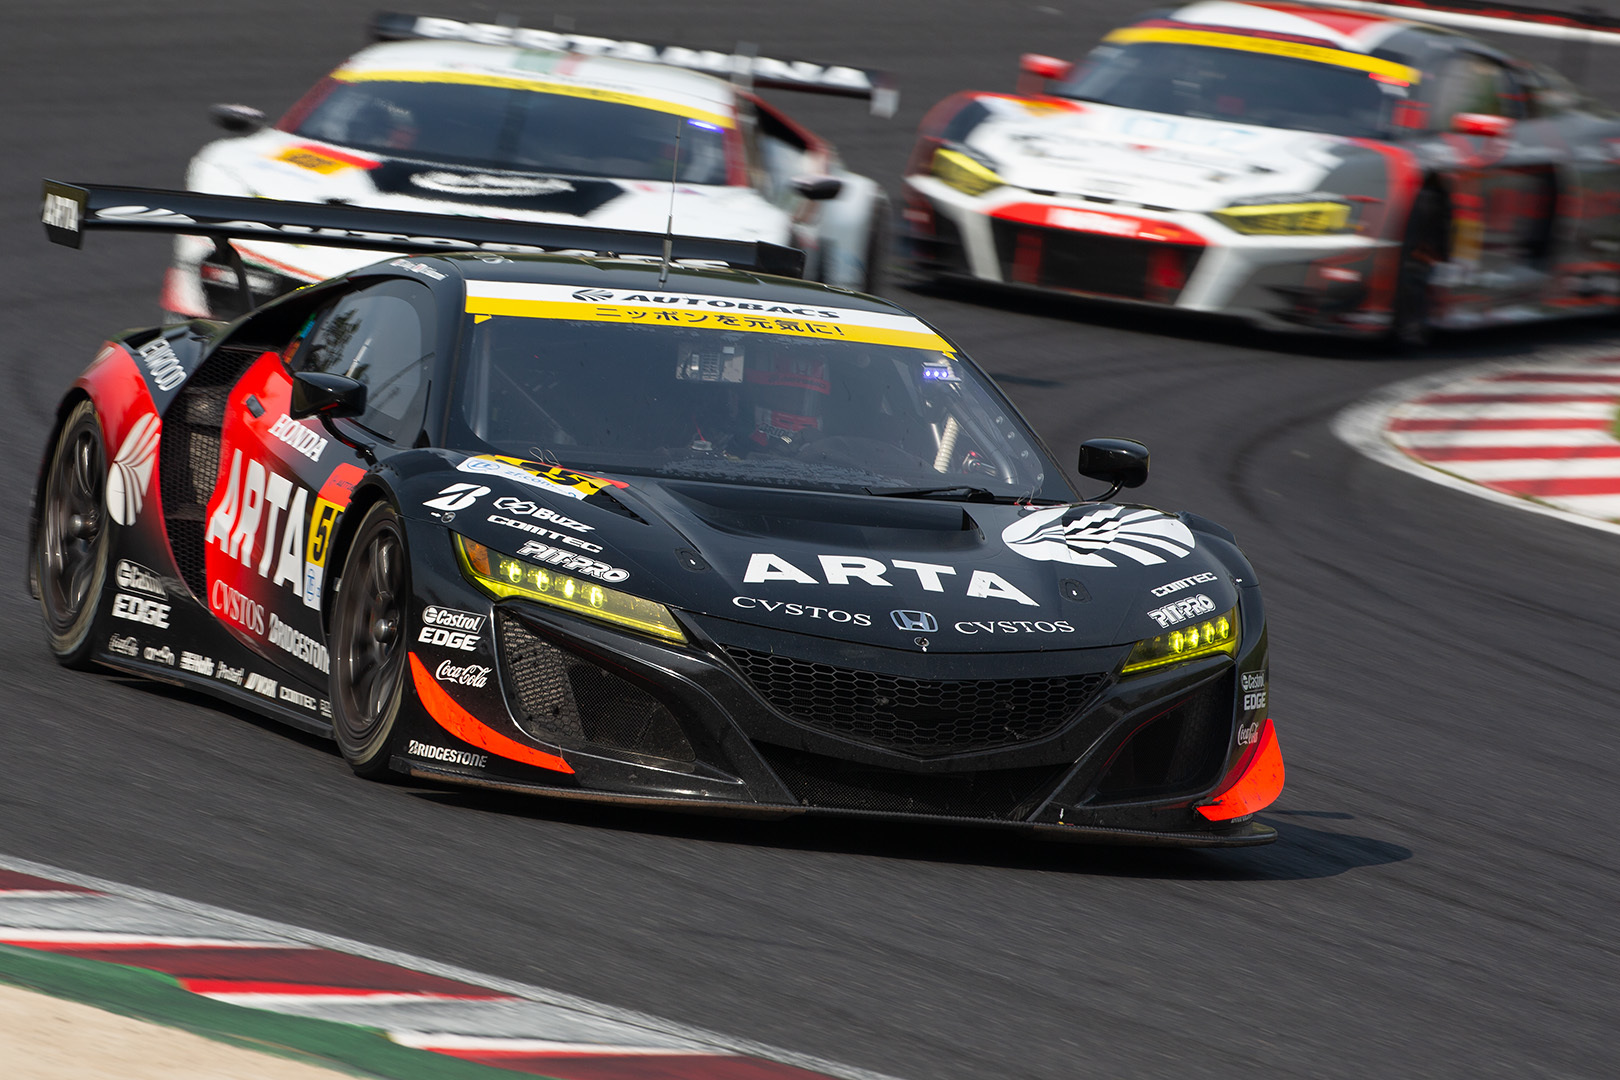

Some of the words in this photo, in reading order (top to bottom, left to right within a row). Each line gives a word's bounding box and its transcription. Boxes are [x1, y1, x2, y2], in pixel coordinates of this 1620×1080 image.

[622, 294, 842, 319] AUTOBACS
[267, 412, 329, 463] HONDA
[204, 447, 309, 598] ARTA
[486, 514, 604, 554] COMTEC
[531, 507, 596, 533] BUZZ
[742, 553, 1041, 608] ARTA
[1150, 571, 1218, 598] COMTEC
[111, 593, 173, 630] EDGE
[211, 579, 265, 636] CVSTOS
[436, 609, 481, 630] Castrol
[732, 595, 872, 627] CVSTOS
[417, 626, 482, 652] EDGE
[954, 620, 1076, 635] CVSTOS
[1243, 692, 1267, 712] EDGE
[407, 739, 488, 768] BRIDGESTONE
